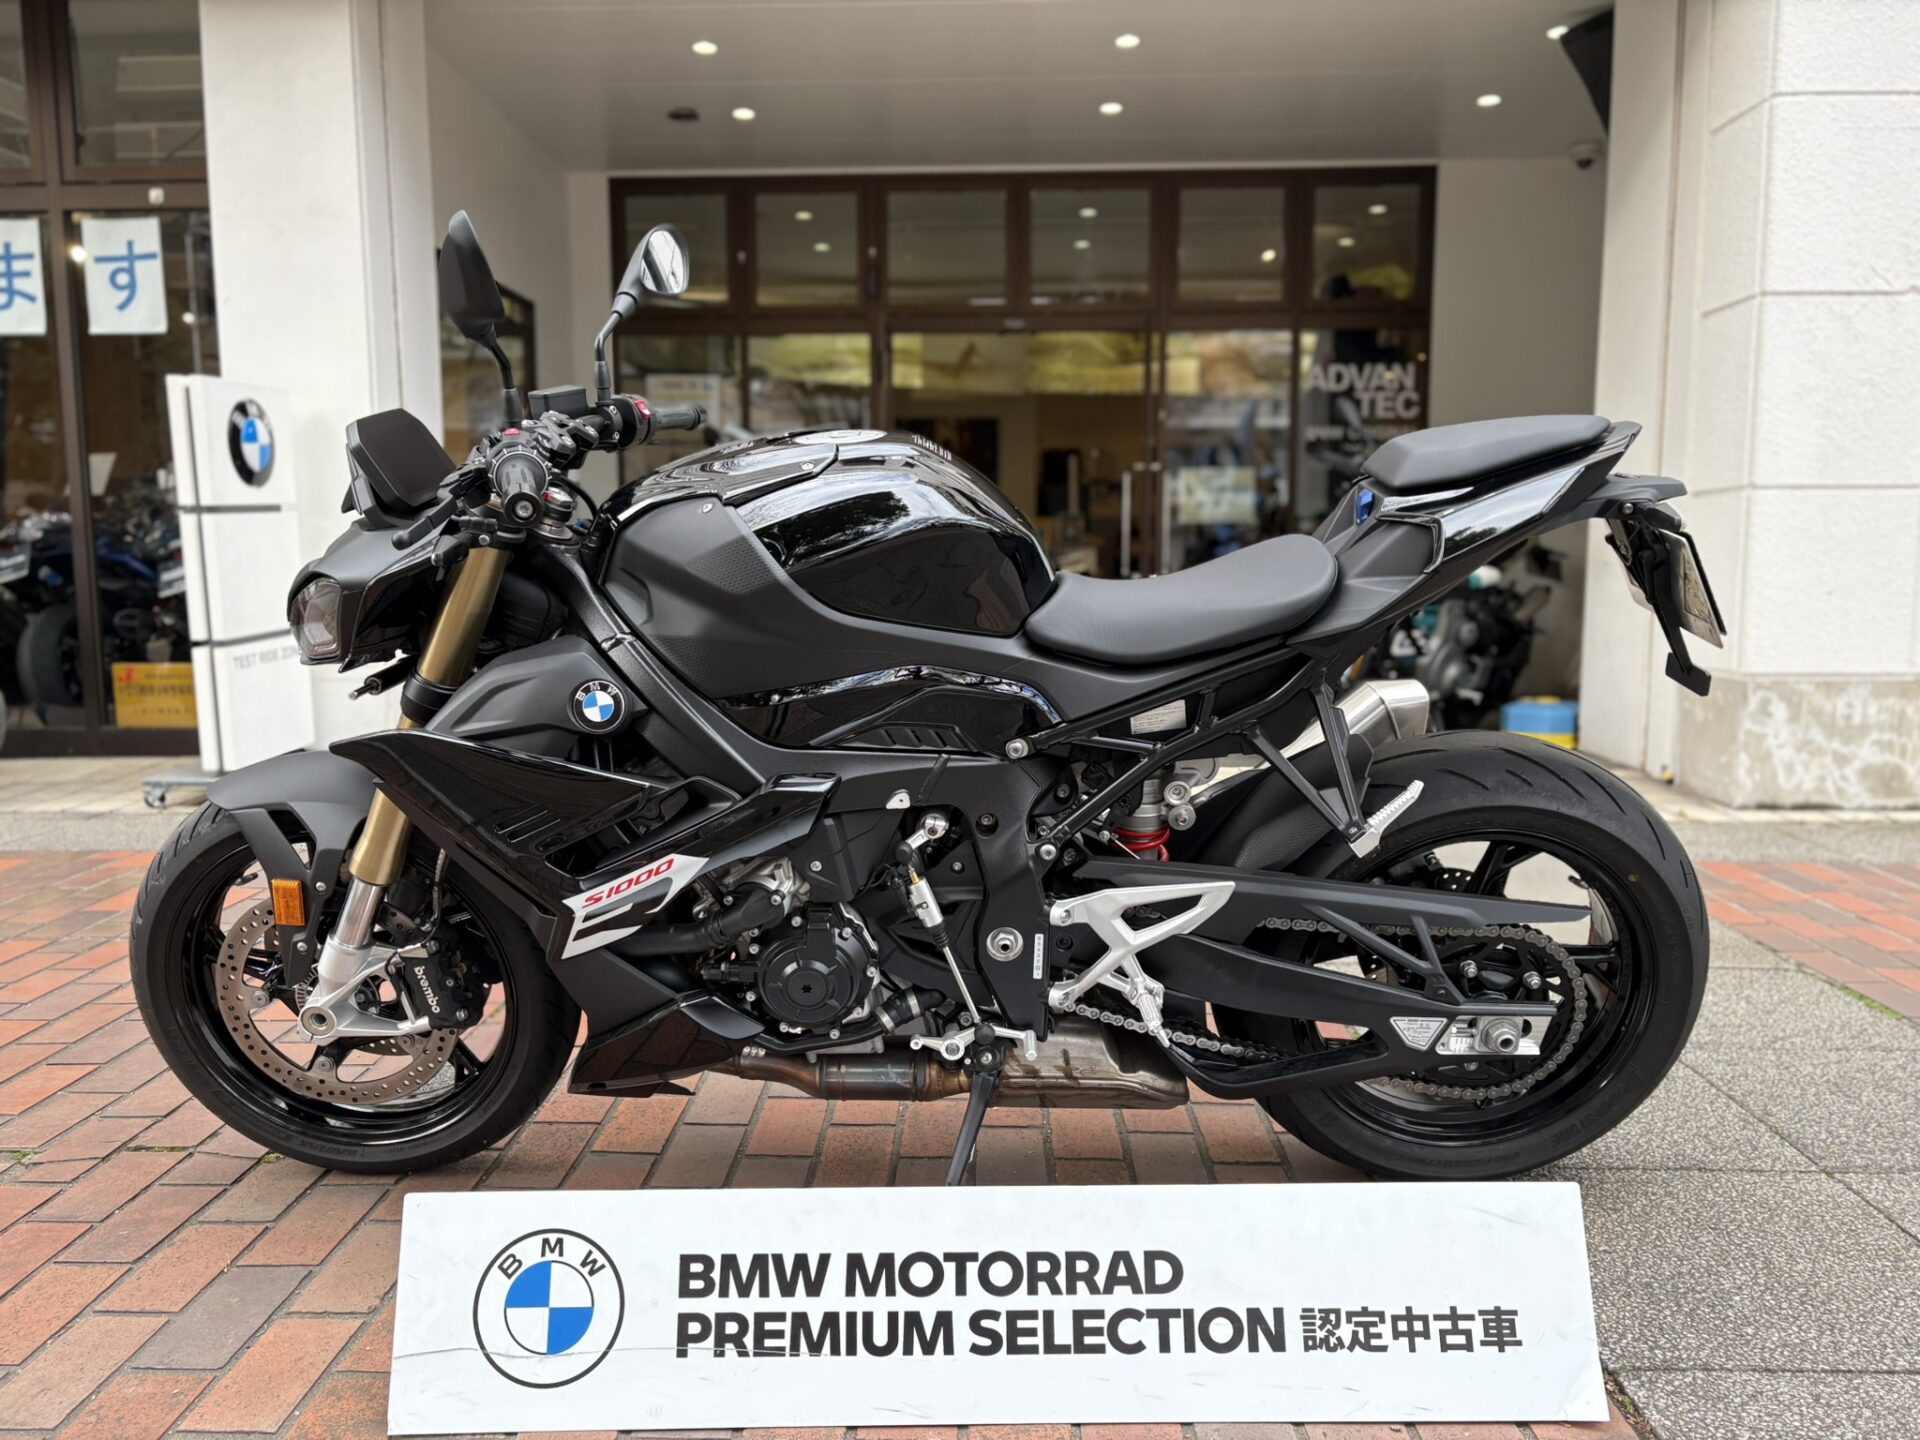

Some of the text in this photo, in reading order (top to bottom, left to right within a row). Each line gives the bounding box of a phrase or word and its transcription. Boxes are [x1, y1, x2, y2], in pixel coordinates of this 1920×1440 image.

[94, 240, 158, 311] す
[1306, 362, 1417, 392] ADVAN
[1353, 389, 1421, 419] TEC
[576, 682, 618, 701] BMW
[583, 858, 675, 908] S1000
[413, 965, 441, 1014] brembo
[497, 1237, 606, 1280] BMW
[678, 1250, 1184, 1299] BMW MOTORRAD
[676, 1306, 1523, 1358] PREMIUM SELECTION 認定中古車
